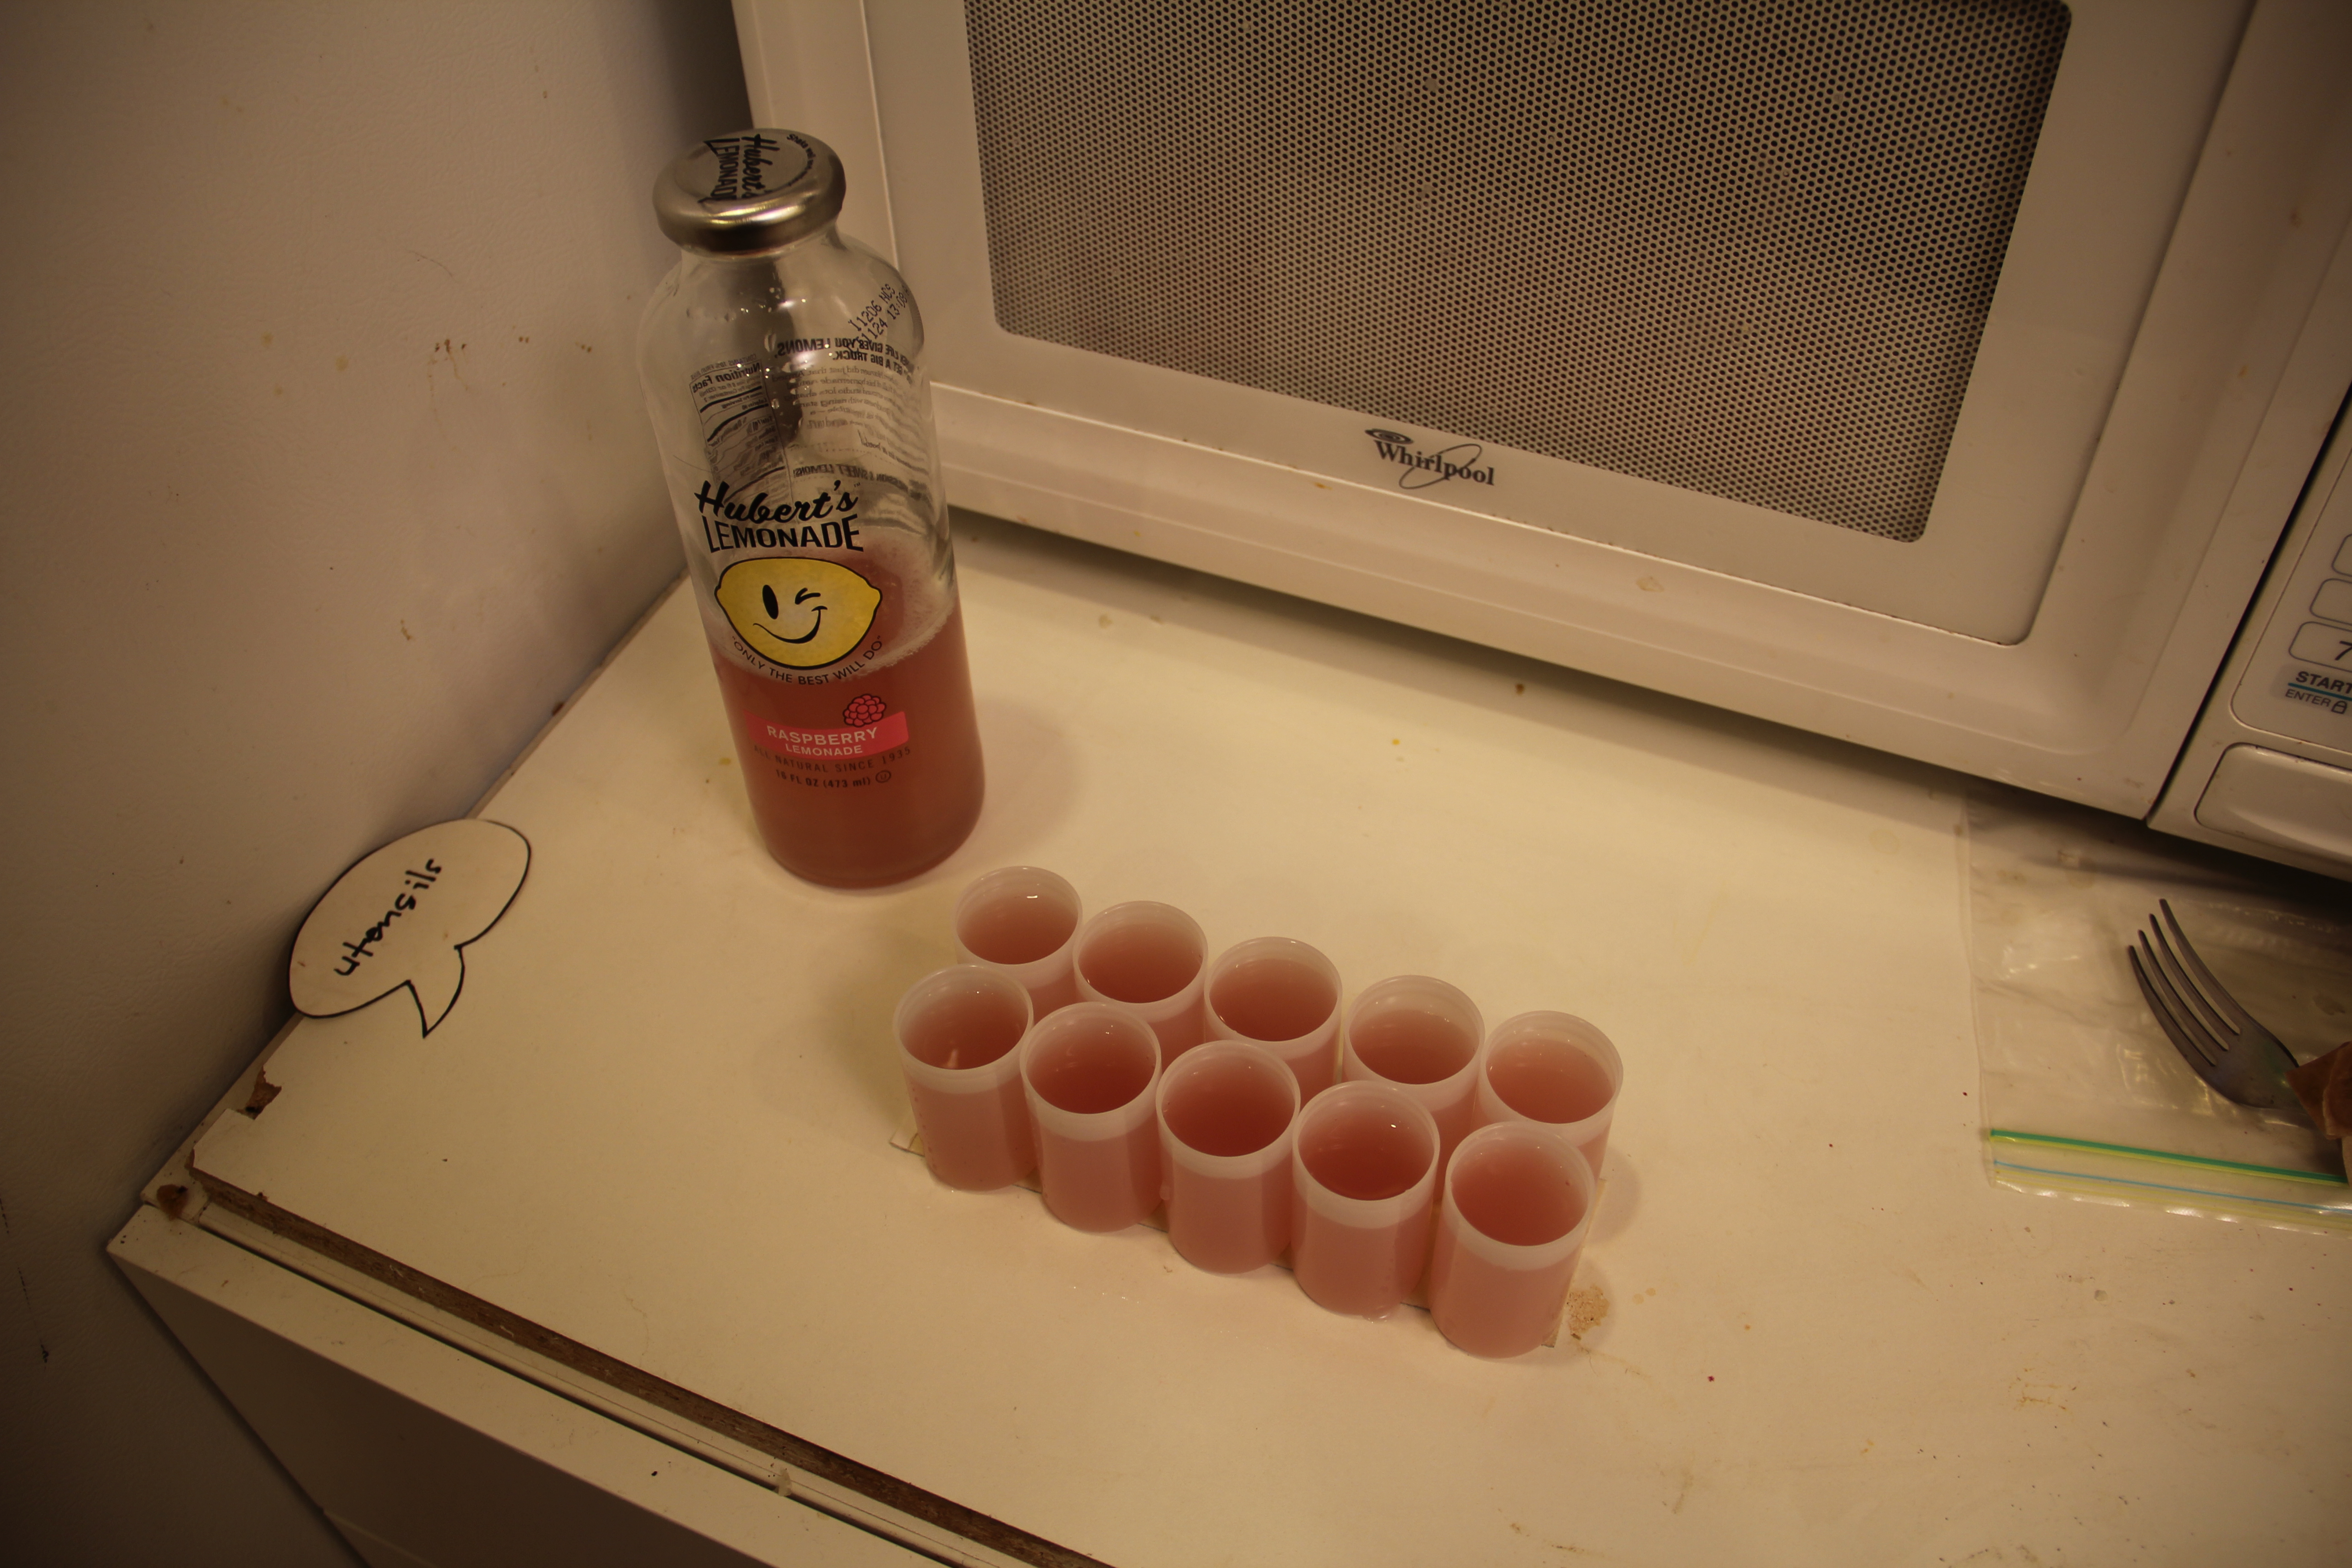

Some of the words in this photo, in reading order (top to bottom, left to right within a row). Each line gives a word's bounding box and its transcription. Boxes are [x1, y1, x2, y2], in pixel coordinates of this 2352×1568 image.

[1373, 439, 1495, 486] Whirlpool
[694, 480, 859, 524] Hubert's
[701, 514, 864, 554] LEMONADE
[769, 667, 793, 684] THE
[798, 673, 830, 686] BEST
[832, 660, 866, 681] WILL
[2285, 689, 2332, 708] ENTER
[766, 725, 878, 746] RASPBERRY
[754, 744, 771, 760] ALL
[774, 754, 829, 774] NATURAL
[834, 759, 875, 773] SINCE
[881, 745, 911, 765] 1935
[785, 743, 863, 757] LEMONADE
[789, 774, 803, 785] FL
[823, 779, 848, 789] (473
